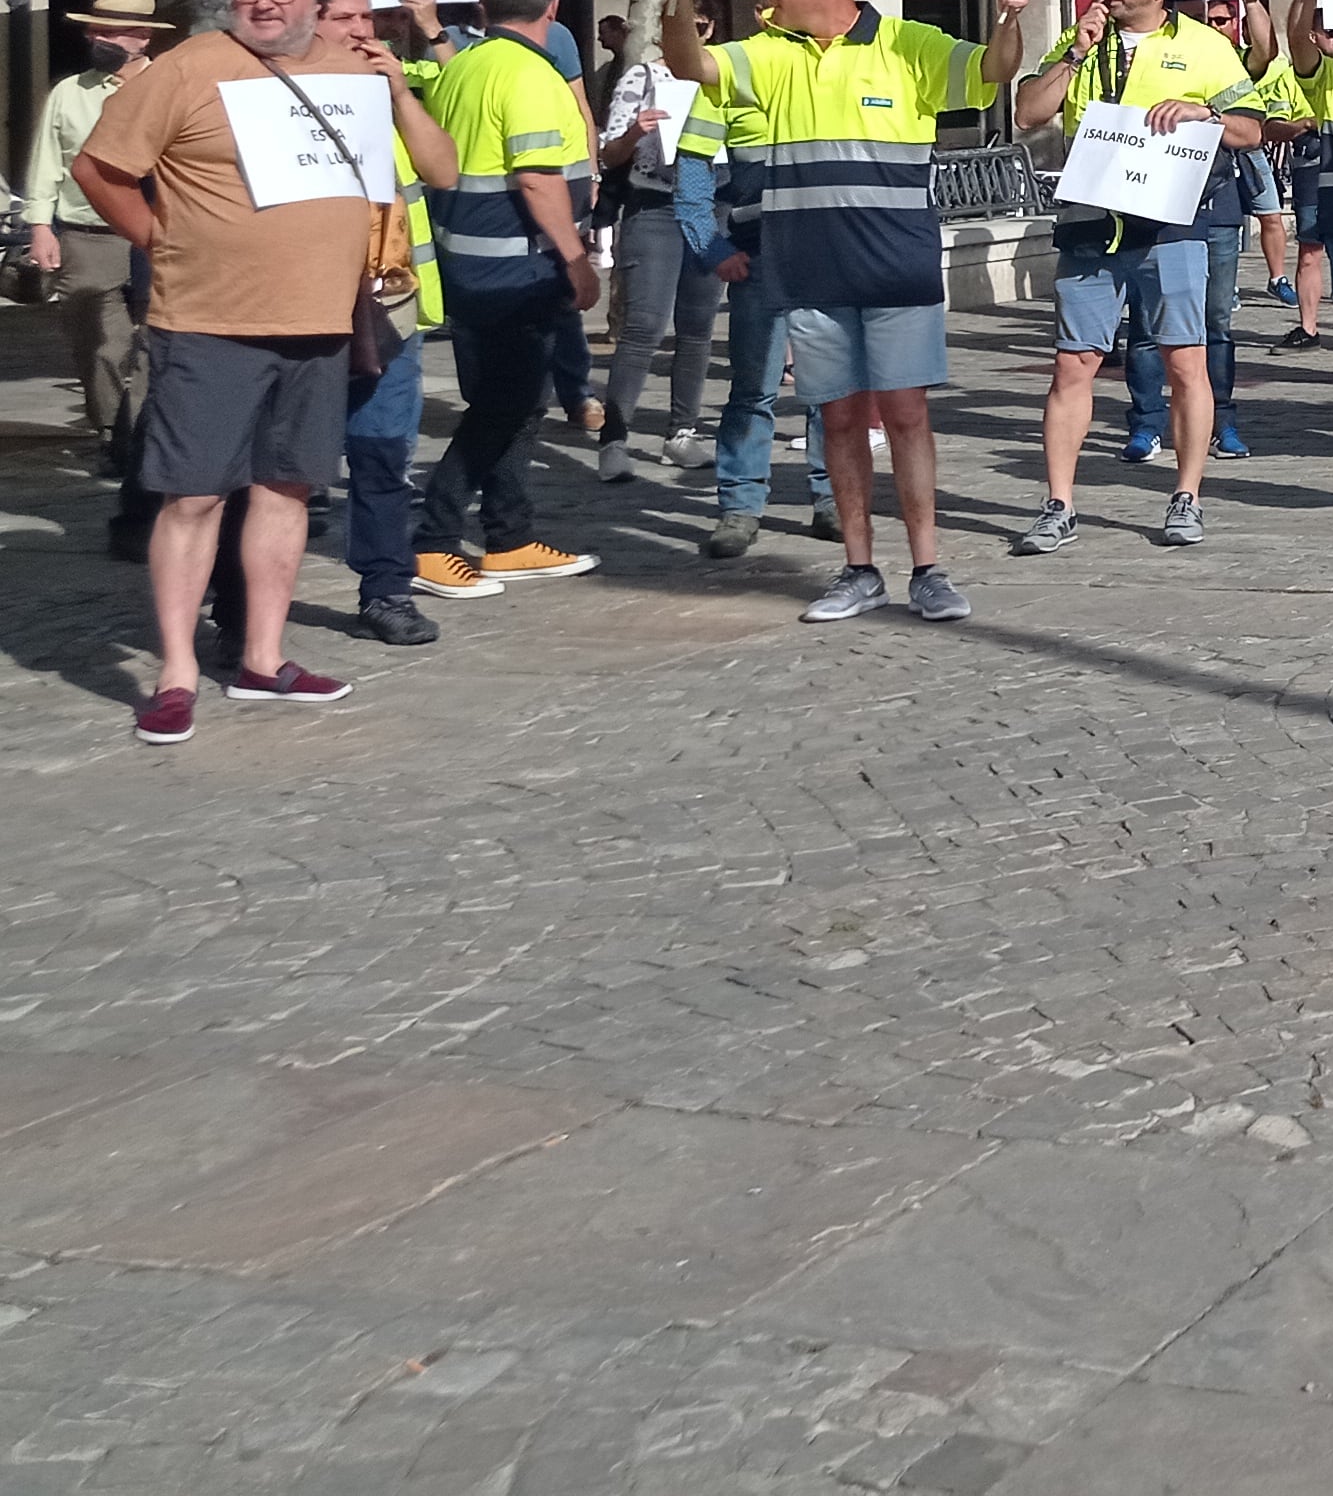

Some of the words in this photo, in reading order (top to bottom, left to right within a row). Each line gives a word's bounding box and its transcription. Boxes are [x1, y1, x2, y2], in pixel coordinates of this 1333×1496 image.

[310, 128, 346, 142] ESA
[1083, 128, 1146, 148] ¡SALARIOS
[1165, 144, 1209, 162] JUSTOS
[297, 153, 319, 166] EN
[1125, 169, 1148, 185] YA!
